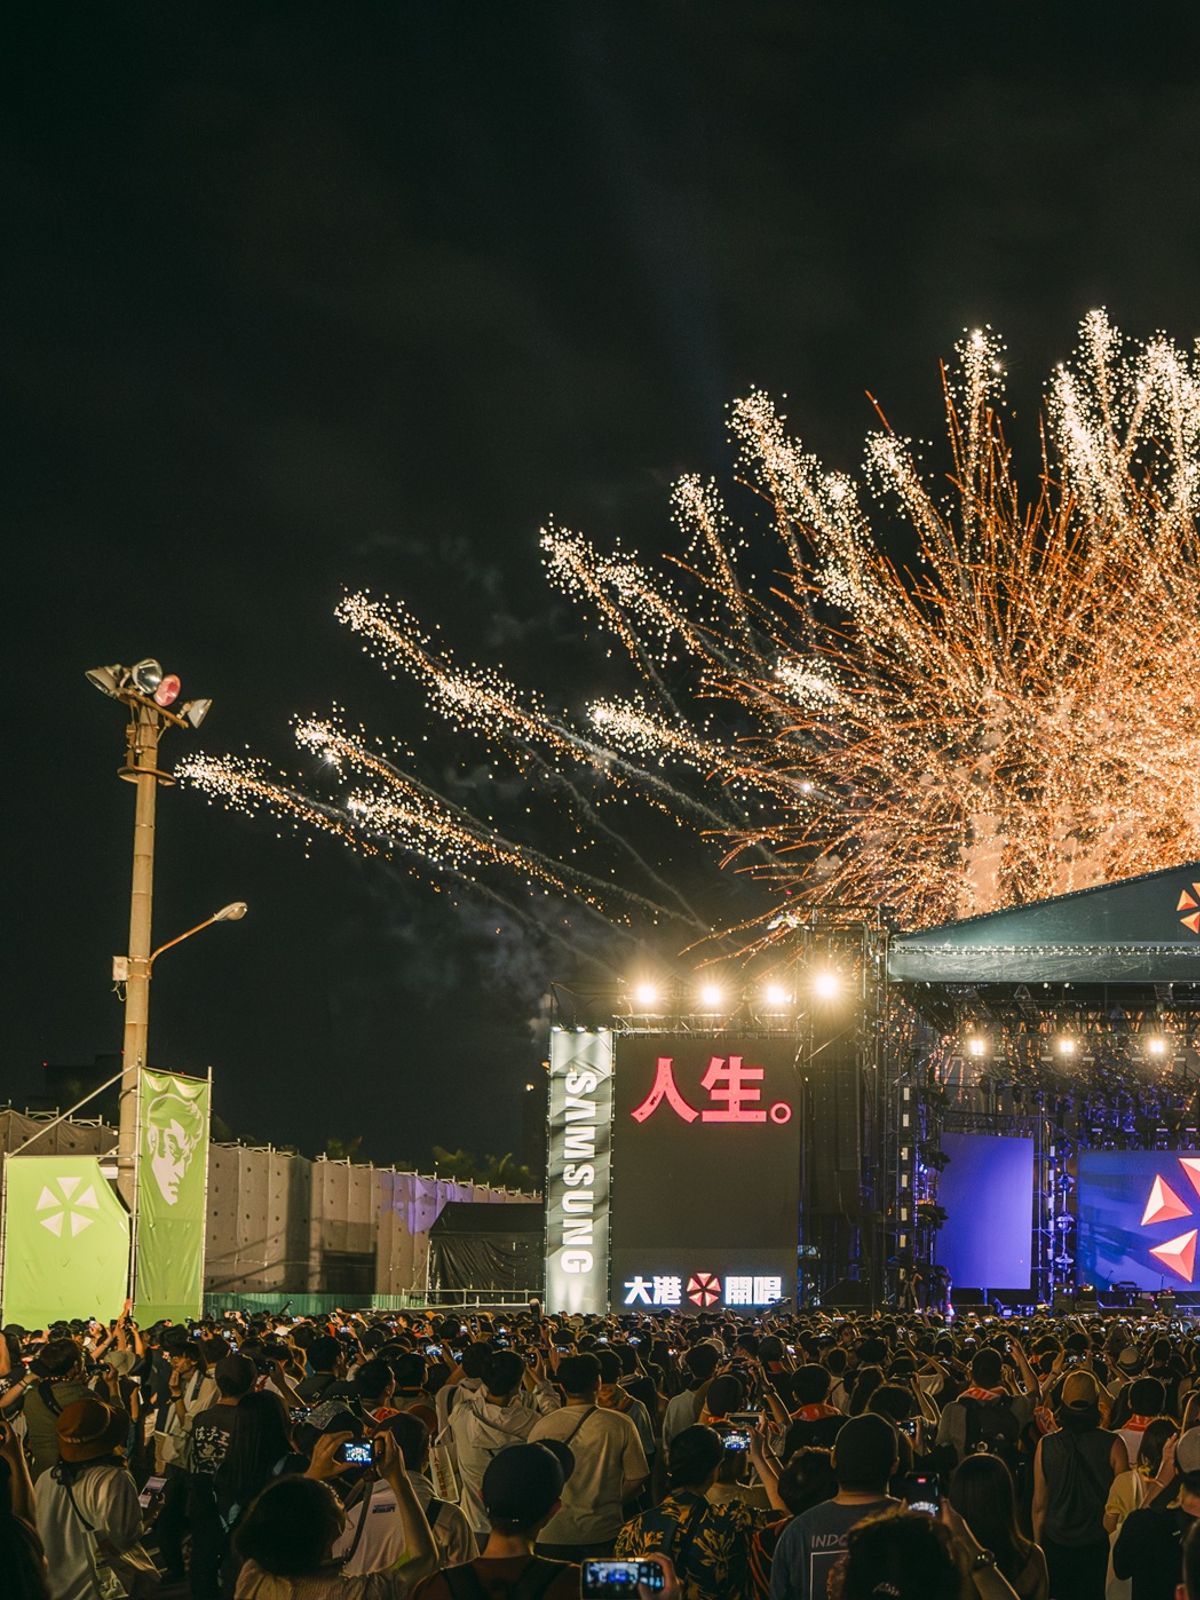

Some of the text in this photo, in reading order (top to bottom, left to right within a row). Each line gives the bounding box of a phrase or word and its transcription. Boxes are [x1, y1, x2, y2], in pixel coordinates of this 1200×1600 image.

[631, 1056, 792, 1124] 人生。
[562, 1071, 598, 1273] SAMSUNG
[624, 1276, 682, 1305] 大港
